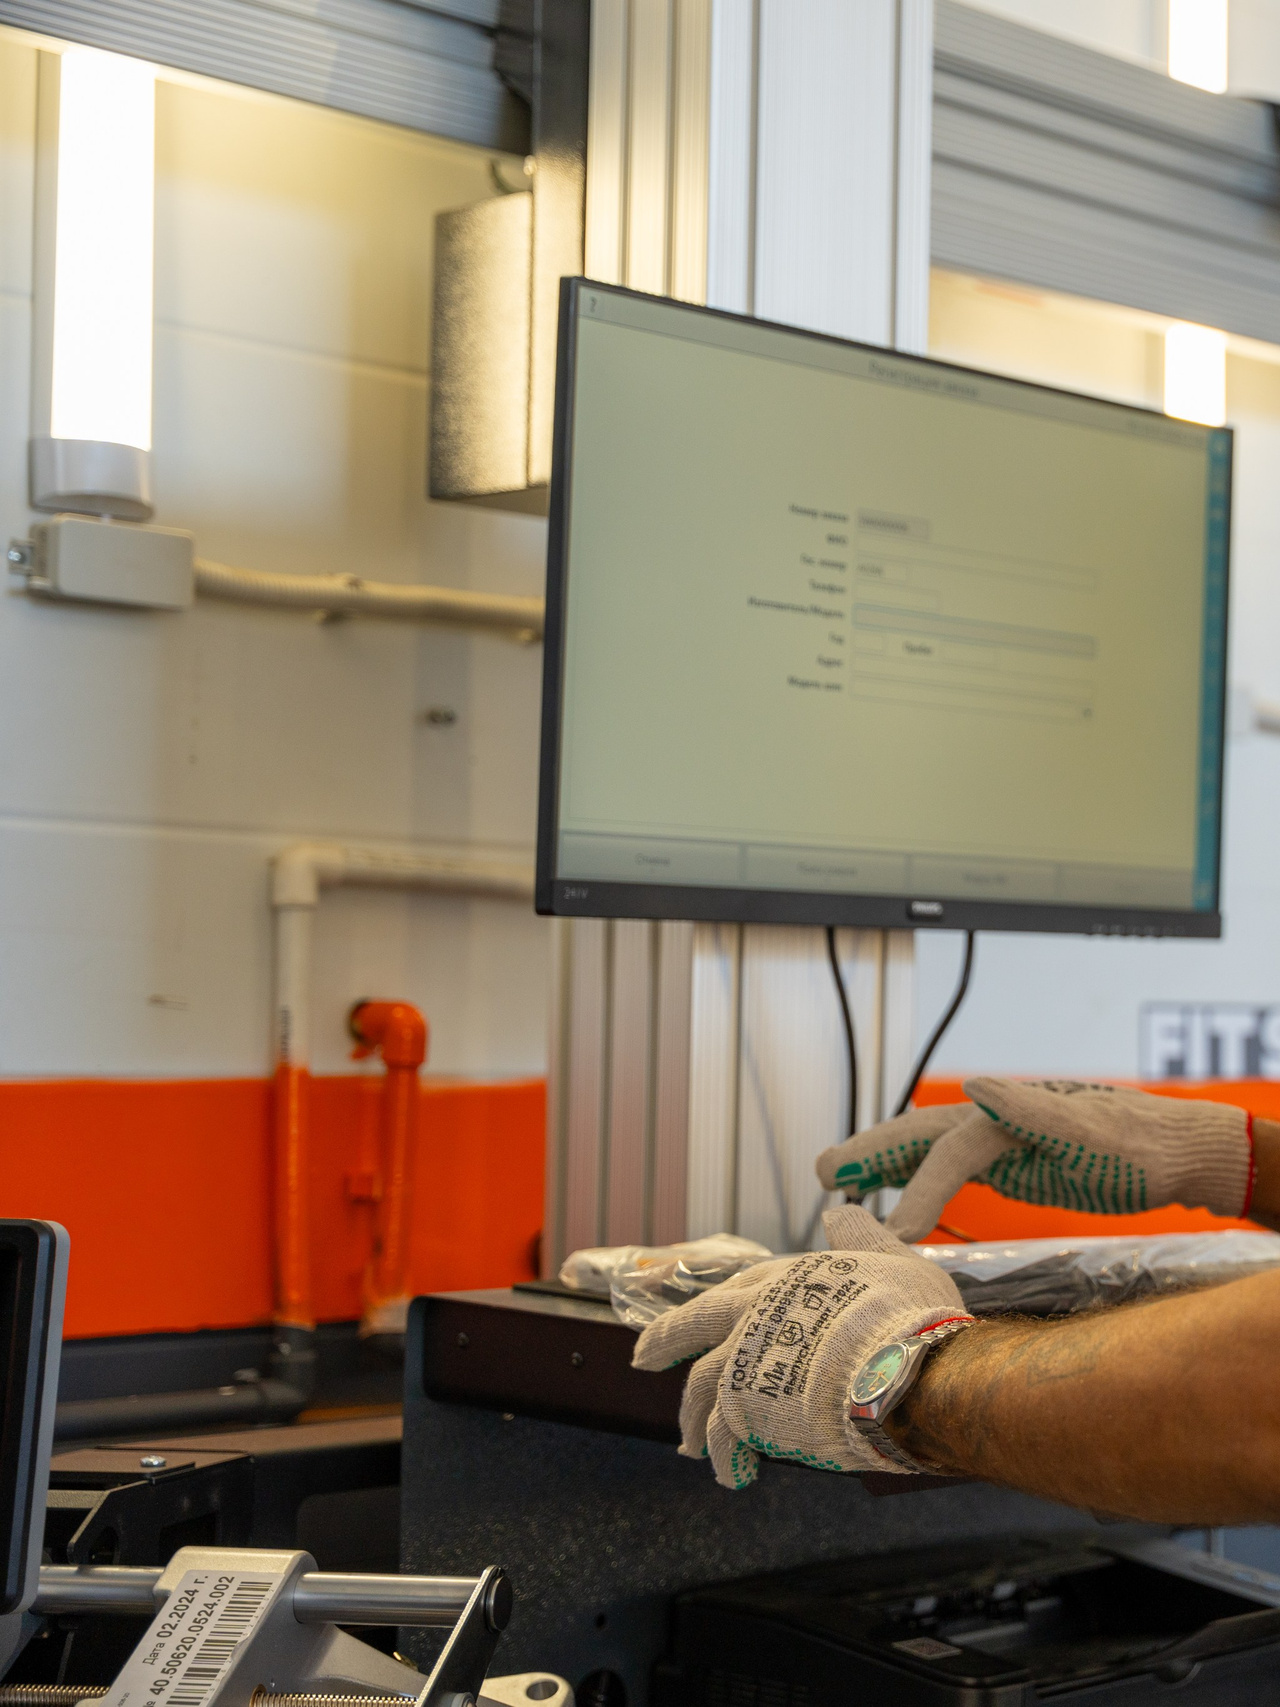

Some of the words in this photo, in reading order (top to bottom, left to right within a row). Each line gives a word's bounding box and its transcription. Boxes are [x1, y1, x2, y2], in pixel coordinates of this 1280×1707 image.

[832, 1280, 857, 1303] 2024
[731, 1347, 751, 1391] ГОСТ
[142, 1642, 166, 1665] Дата
[156, 1588, 200, 1638] 02.2024
[149, 1576, 235, 1696] 40.50620.0524.002
